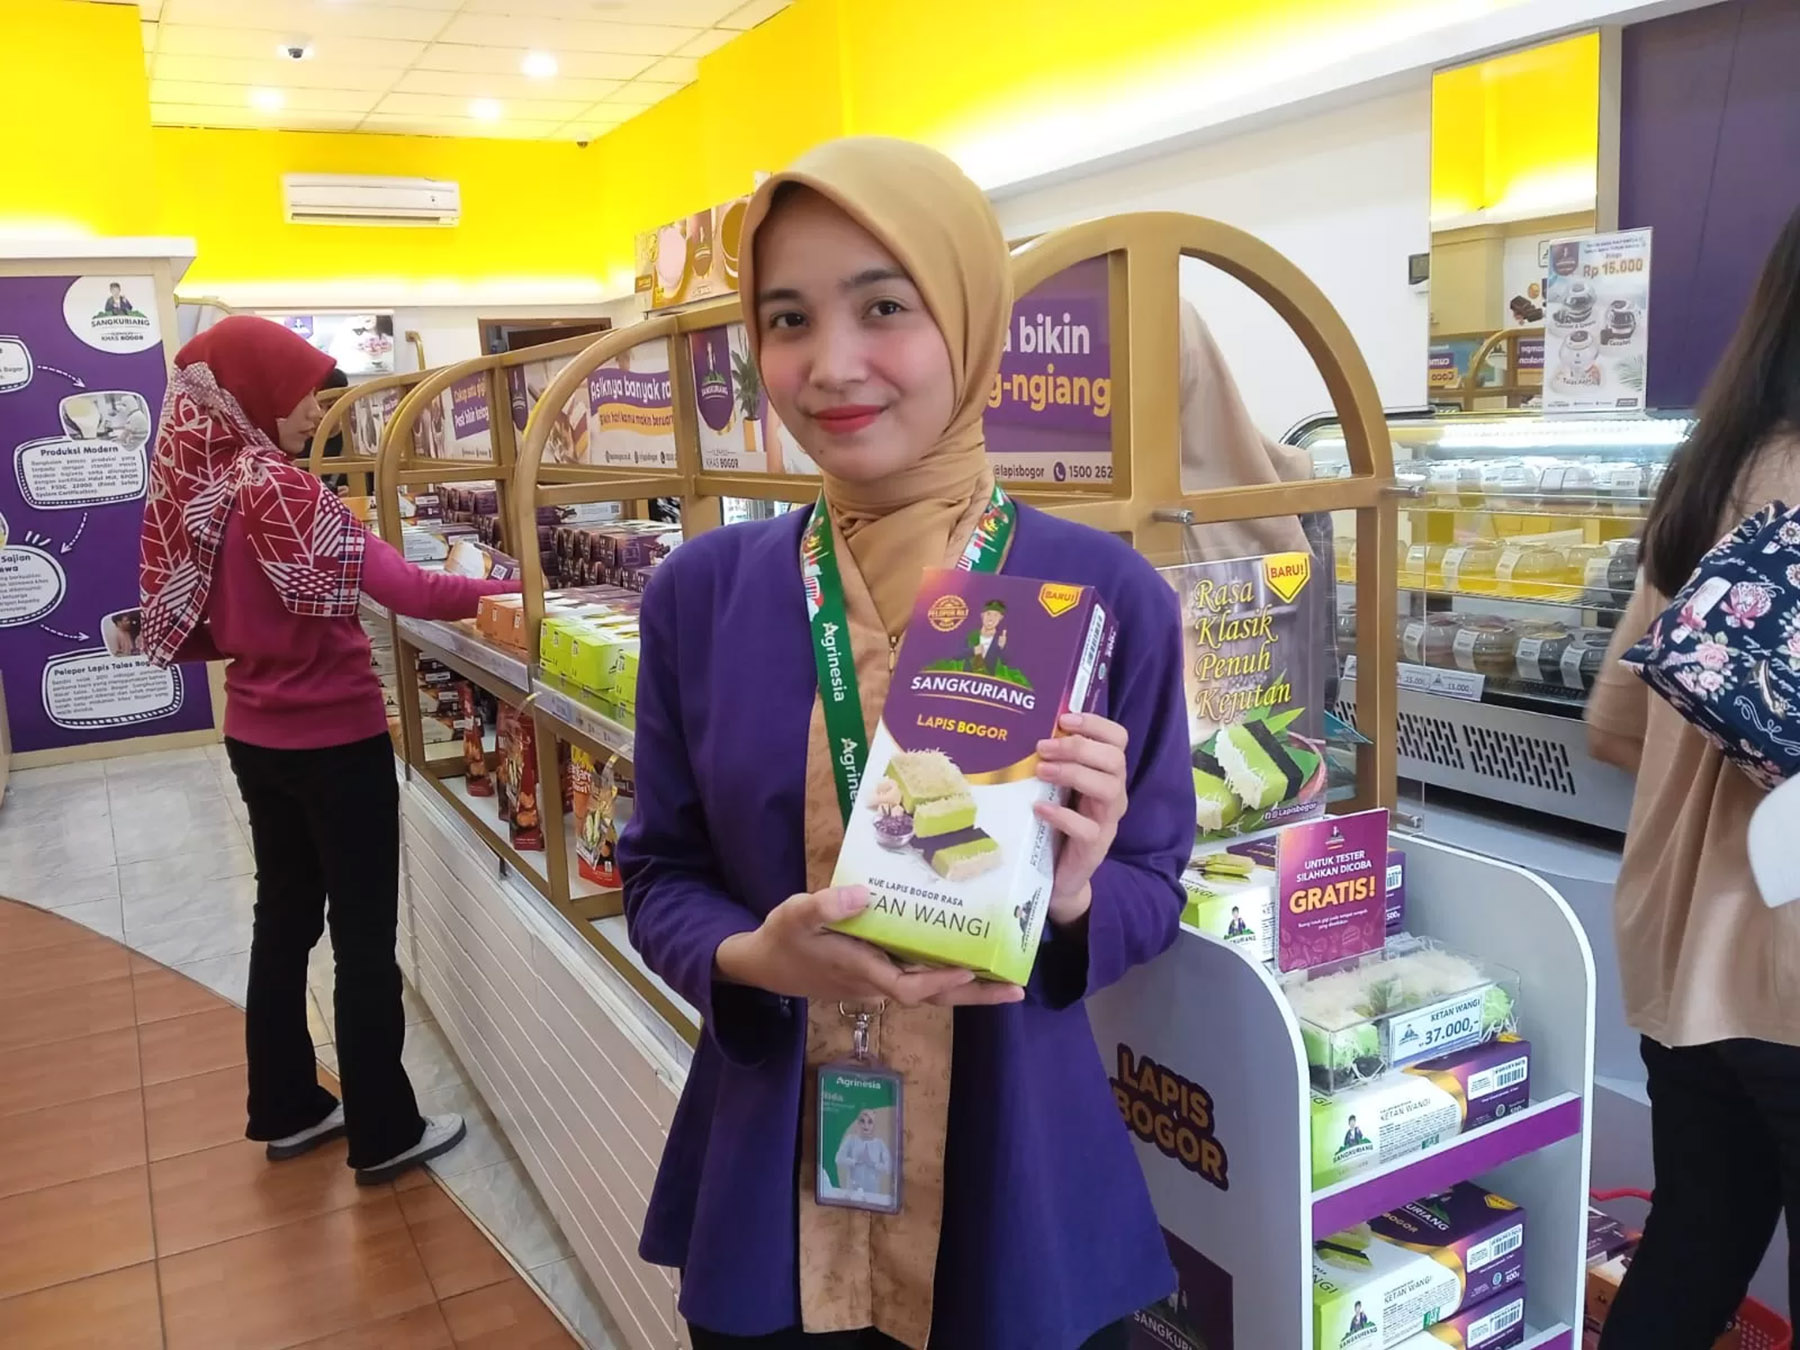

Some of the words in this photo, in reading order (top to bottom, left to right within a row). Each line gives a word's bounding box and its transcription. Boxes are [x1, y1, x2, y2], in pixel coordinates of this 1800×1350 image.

[1584, 265, 1599, 279] Rp
[1602, 258, 1643, 276] 15.000
[91, 317, 151, 328] SANGKURIANG
[1019, 312, 1090, 355] bikin
[591, 375, 623, 403] Asiknya
[624, 376, 660, 404] banyak
[662, 380, 672, 400] ra
[40, 447, 80, 457] Produksi
[84, 446, 118, 454] Modern
[993, 464, 1045, 480] @lapisbogor
[1069, 465, 1092, 478] 1500
[1095, 465, 1113, 479] 262
[1, 554, 31, 564] Sajian
[1270, 563, 1304, 579] BARU!
[1044, 590, 1074, 602] BARU!
[1195, 579, 1254, 613] Rasa
[1195, 603, 1279, 649] Klasik
[88, 664, 109, 672] Lapis
[112, 662, 133, 670] Talas
[821, 622, 845, 703] Agrinesia
[1195, 640, 1271, 683] Penuh
[910, 675, 1036, 710] SANGKURIANG
[1196, 682, 1292, 723] Kejutan
[917, 713, 956, 731] LAPIS
[957, 720, 1008, 741] BOGOR
[1296, 867, 1339, 882] SILAHKAN
[1340, 860, 1372, 874] DICOBA
[1304, 856, 1335, 869] UNTUK
[1336, 850, 1365, 863] TESTER
[868, 877, 885, 888] KUE
[885, 881, 909, 894] LAPIS
[909, 887, 940, 901] BOGOR
[941, 894, 963, 907] RASA
[1289, 875, 1376, 914] GRATIS!
[915, 902, 990, 939] WANGI
[1430, 1007, 1455, 1022] KETAN
[1455, 998, 1481, 1014] WANGI
[1425, 1017, 1479, 1046] 37.000,-
[837, 1076, 881, 1090] Agrinesia
[1119, 1051, 1209, 1130] LAPIS
[1112, 1086, 1224, 1181] BOGOR
[1332, 1144, 1374, 1164] SANGKURIANG
[1405, 1203, 1450, 1231] URIANG
[1312, 1274, 1339, 1295] NGI
[1384, 1289, 1408, 1304] KETAN
[1408, 1274, 1433, 1294] WANGI
[1339, 1326, 1378, 1349] SANGKURIANG
